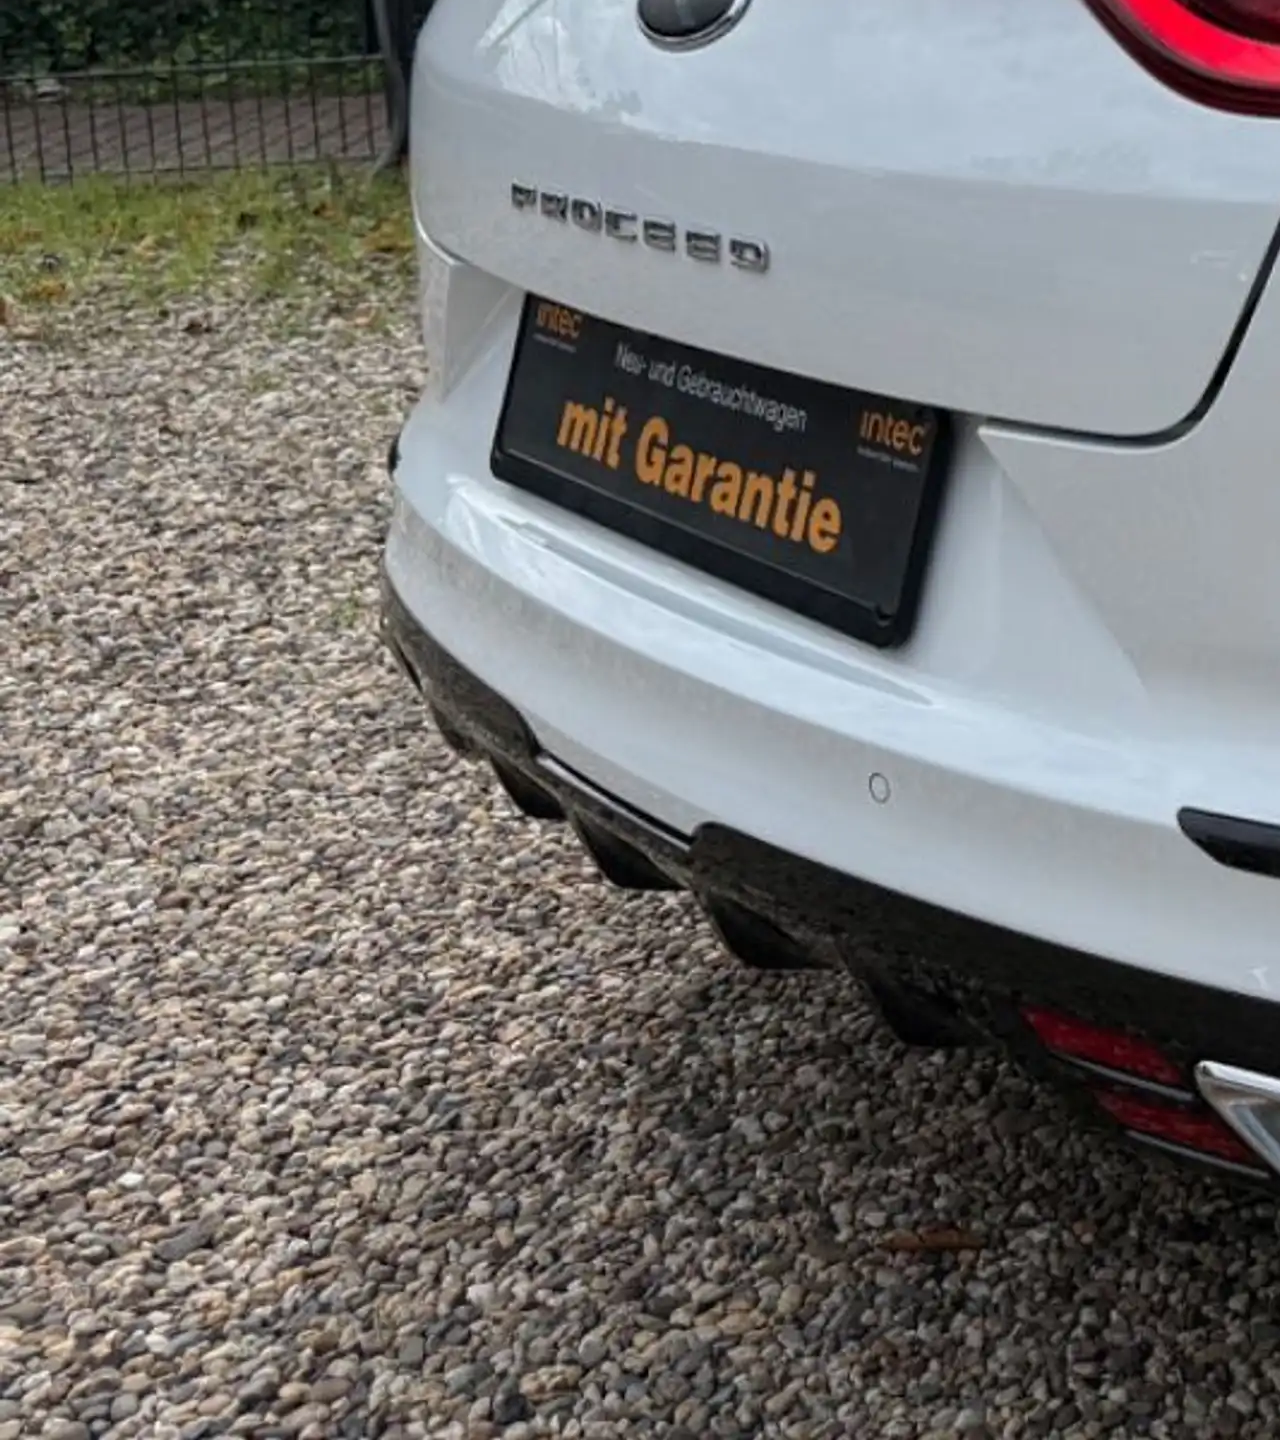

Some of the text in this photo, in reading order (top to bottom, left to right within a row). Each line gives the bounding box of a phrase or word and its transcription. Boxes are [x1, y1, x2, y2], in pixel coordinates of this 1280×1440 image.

[510, 179, 770, 274] PROCEED
[557, 395, 842, 554] mit Garantie
[859, 410, 926, 457] intec
